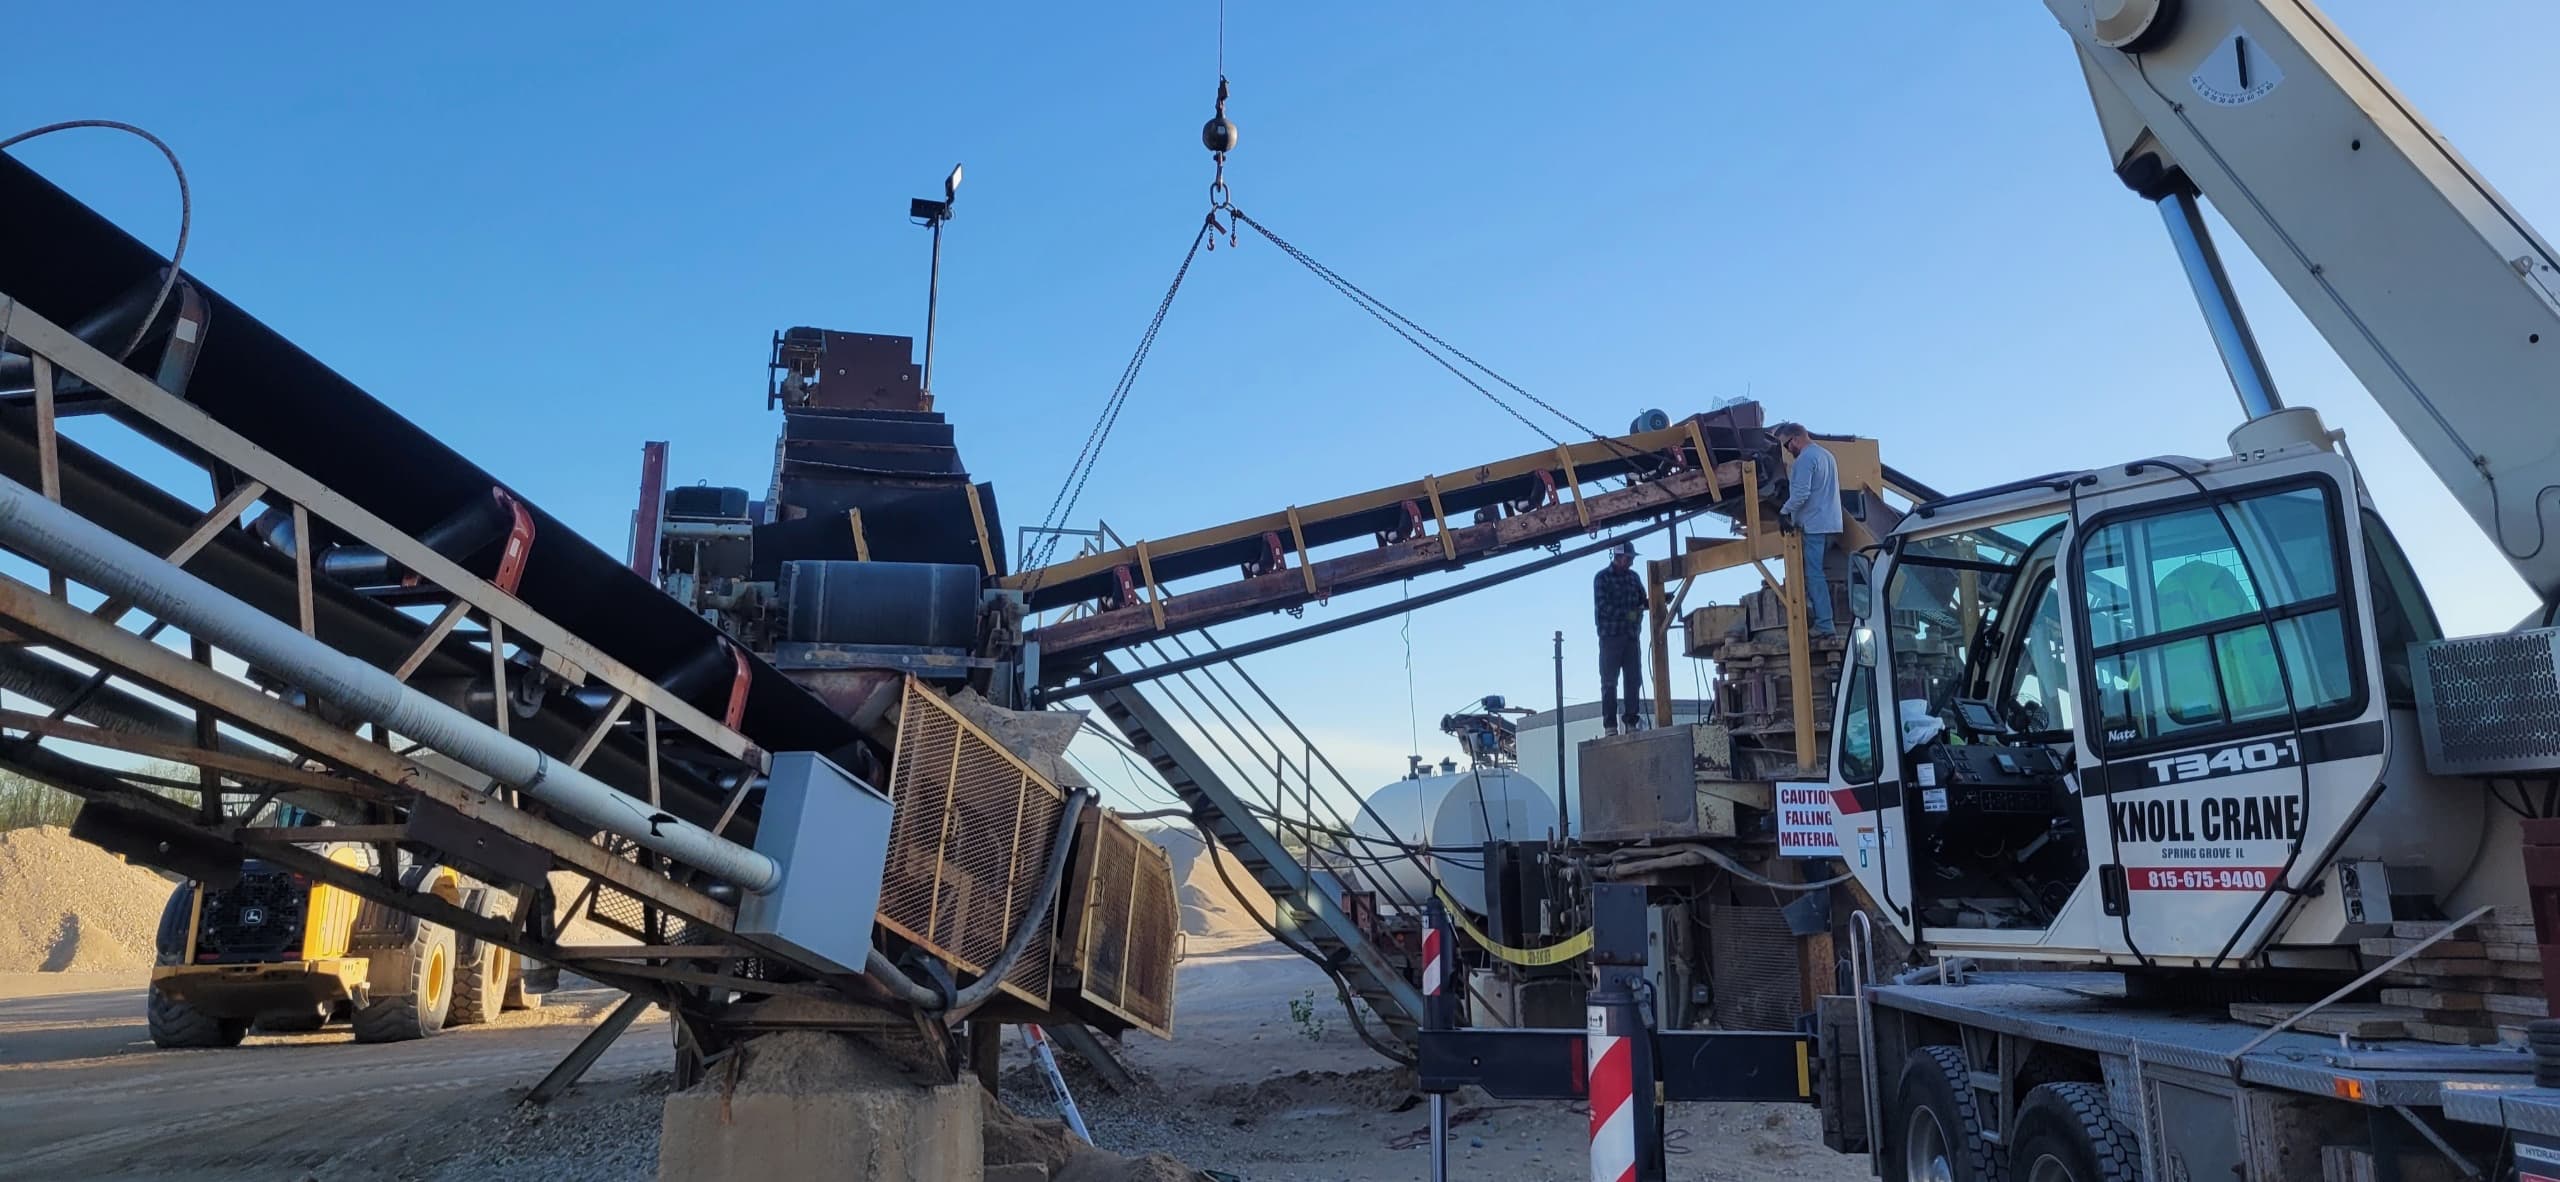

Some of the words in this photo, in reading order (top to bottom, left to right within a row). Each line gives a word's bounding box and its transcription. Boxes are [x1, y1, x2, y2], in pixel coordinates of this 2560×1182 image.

[2108, 729, 2136, 742] Nate
[2148, 738, 2300, 783] T340-1
[1781, 789, 1830, 804] CAUTIO
[1785, 810, 1832, 825] FALLING
[2112, 800, 2195, 843] KNOLL
[2201, 795, 2300, 841] CRANE
[2161, 848, 2197, 859] SPRING
[2199, 848, 2232, 859] GROVE
[2235, 847, 2245, 858] IL
[2148, 870, 2266, 888] 815-675-9400
